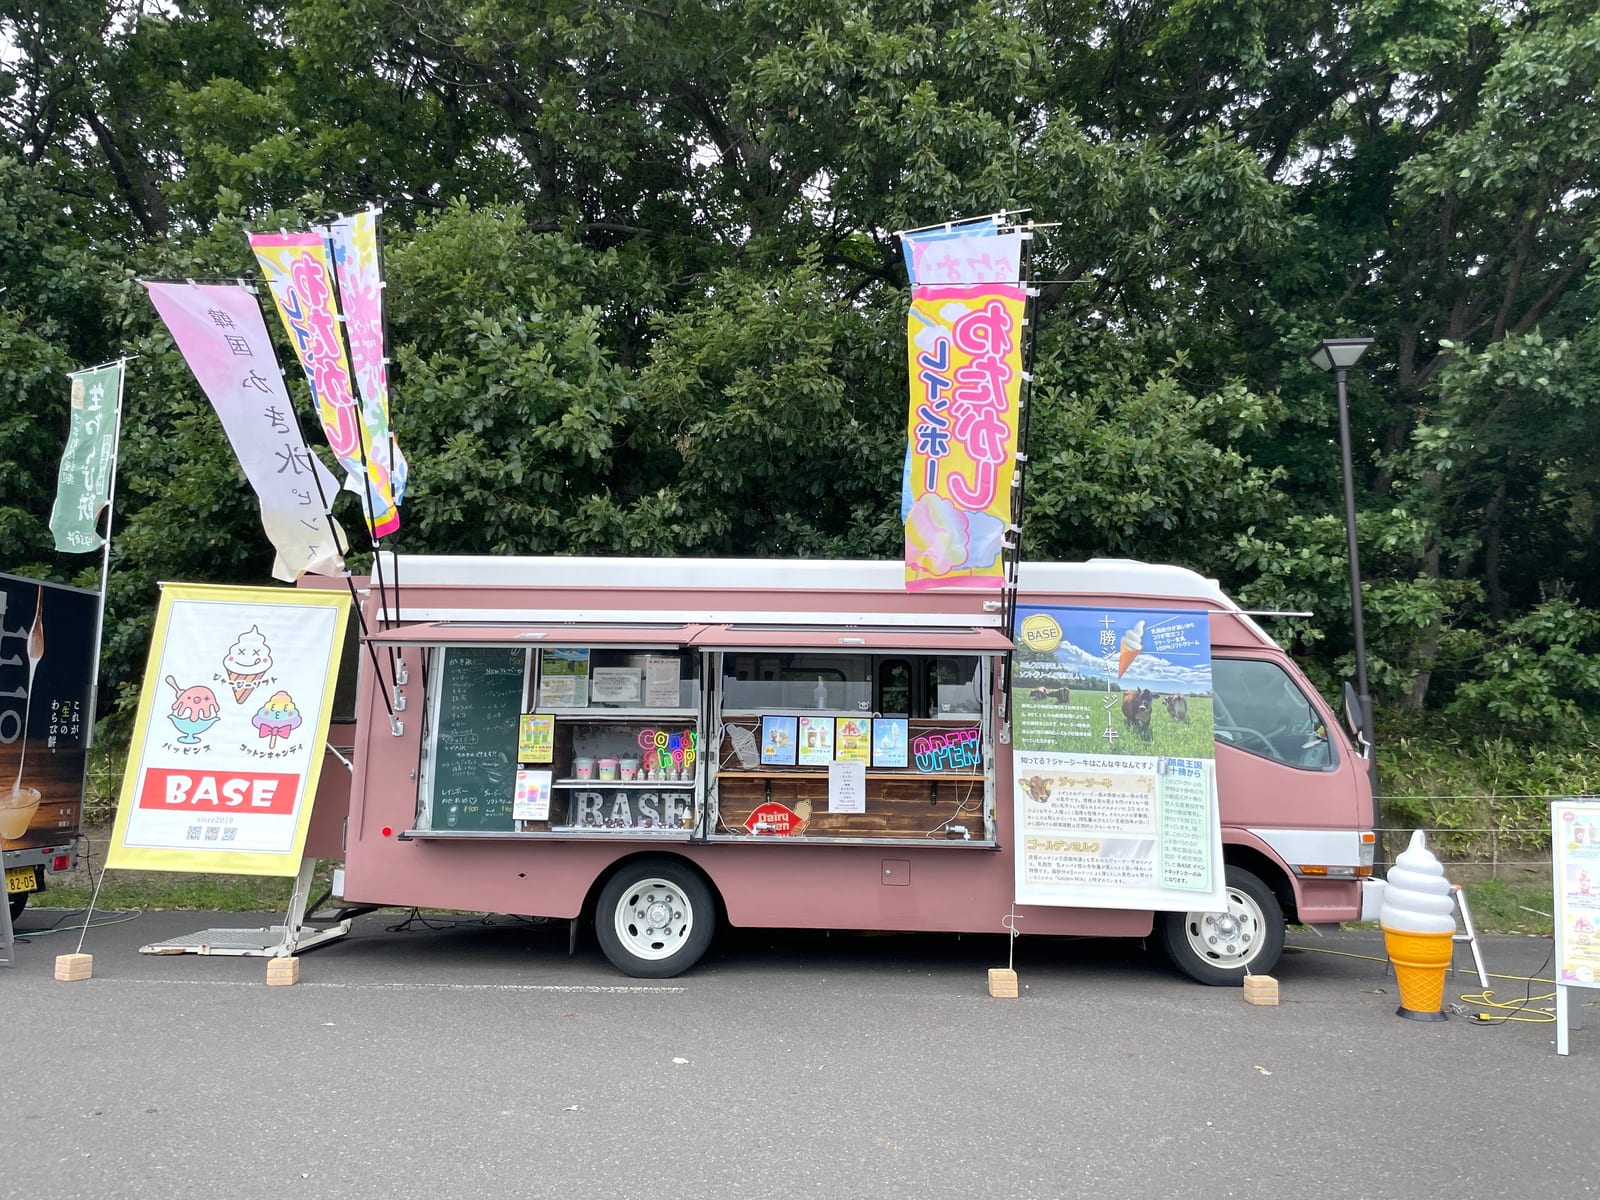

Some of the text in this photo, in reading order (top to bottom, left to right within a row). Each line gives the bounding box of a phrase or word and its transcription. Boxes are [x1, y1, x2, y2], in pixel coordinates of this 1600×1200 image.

[1027, 628, 1057, 641] BASE
[213, 673, 278, 689] ジャージーソフト
[1098, 614, 1119, 744] 十勝ジャージー牛
[161, 742, 212, 755] パッピンス
[638, 729, 698, 751] Candy
[239, 743, 303, 760] コットンキャンディ
[913, 730, 981, 773] OPEN
[165, 775, 279, 807] BASE
[575, 792, 691, 826] BASE
[757, 811, 789, 822] Dairy
[1027, 839, 1100, 853] ゴールデンミルク
